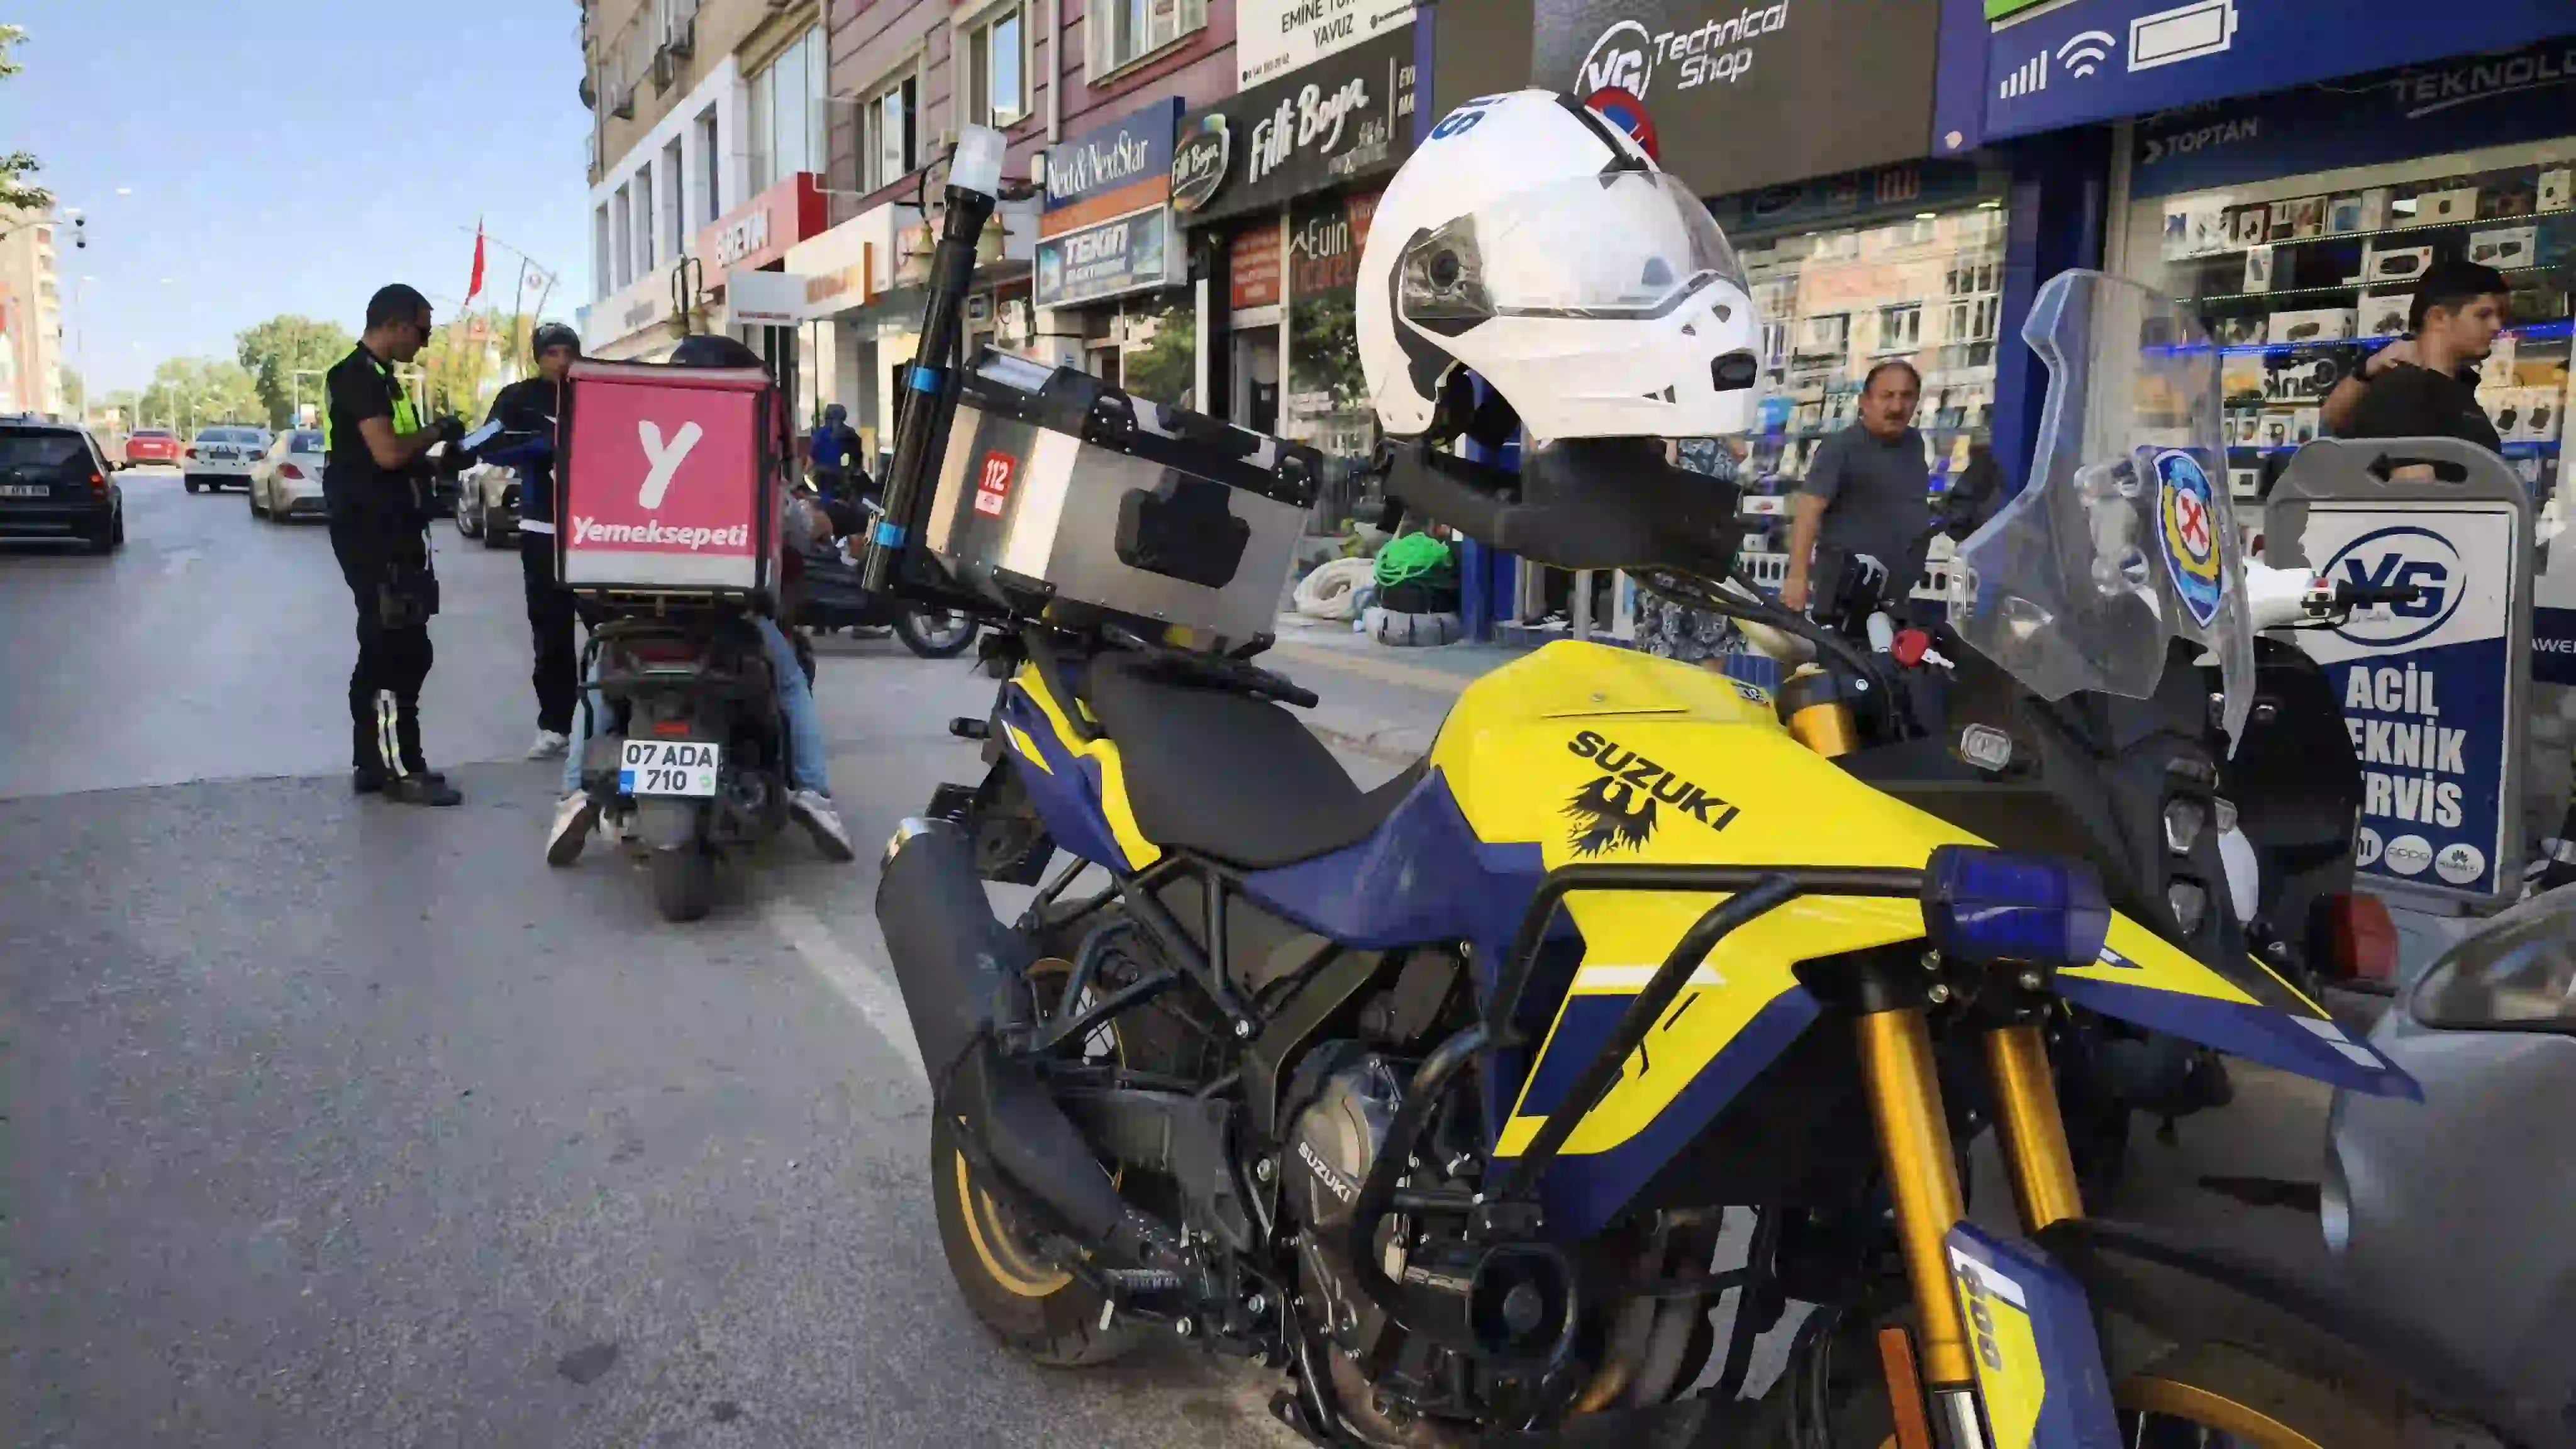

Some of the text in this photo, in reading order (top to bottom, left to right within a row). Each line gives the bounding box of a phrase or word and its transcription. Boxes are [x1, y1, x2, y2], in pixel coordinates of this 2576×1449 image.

[1314, 13, 1353, 48] YAVUZ
[1654, 0, 1789, 65] Technical
[1588, 48, 1643, 96] VG
[1677, 48, 1753, 89] Shop
[1297, 78, 1370, 153] Boya
[2166, 117, 2258, 157] TOPTAN
[1047, 130, 1149, 203] Next & NextStar
[984, 458, 1009, 491] 112
[572, 514, 749, 550] Yemeksepeti
[2345, 553, 2448, 618] VG
[2345, 662, 2440, 716] ACİL
[626, 744, 713, 768] 07 ADA
[2345, 716, 2467, 774] EKNİK
[647, 769, 687, 791] 710
[1568, 730, 1741, 833] SUZUKI
[2361, 771, 2463, 828] RVİS
[1297, 1141, 1351, 1203] SUZUKI
